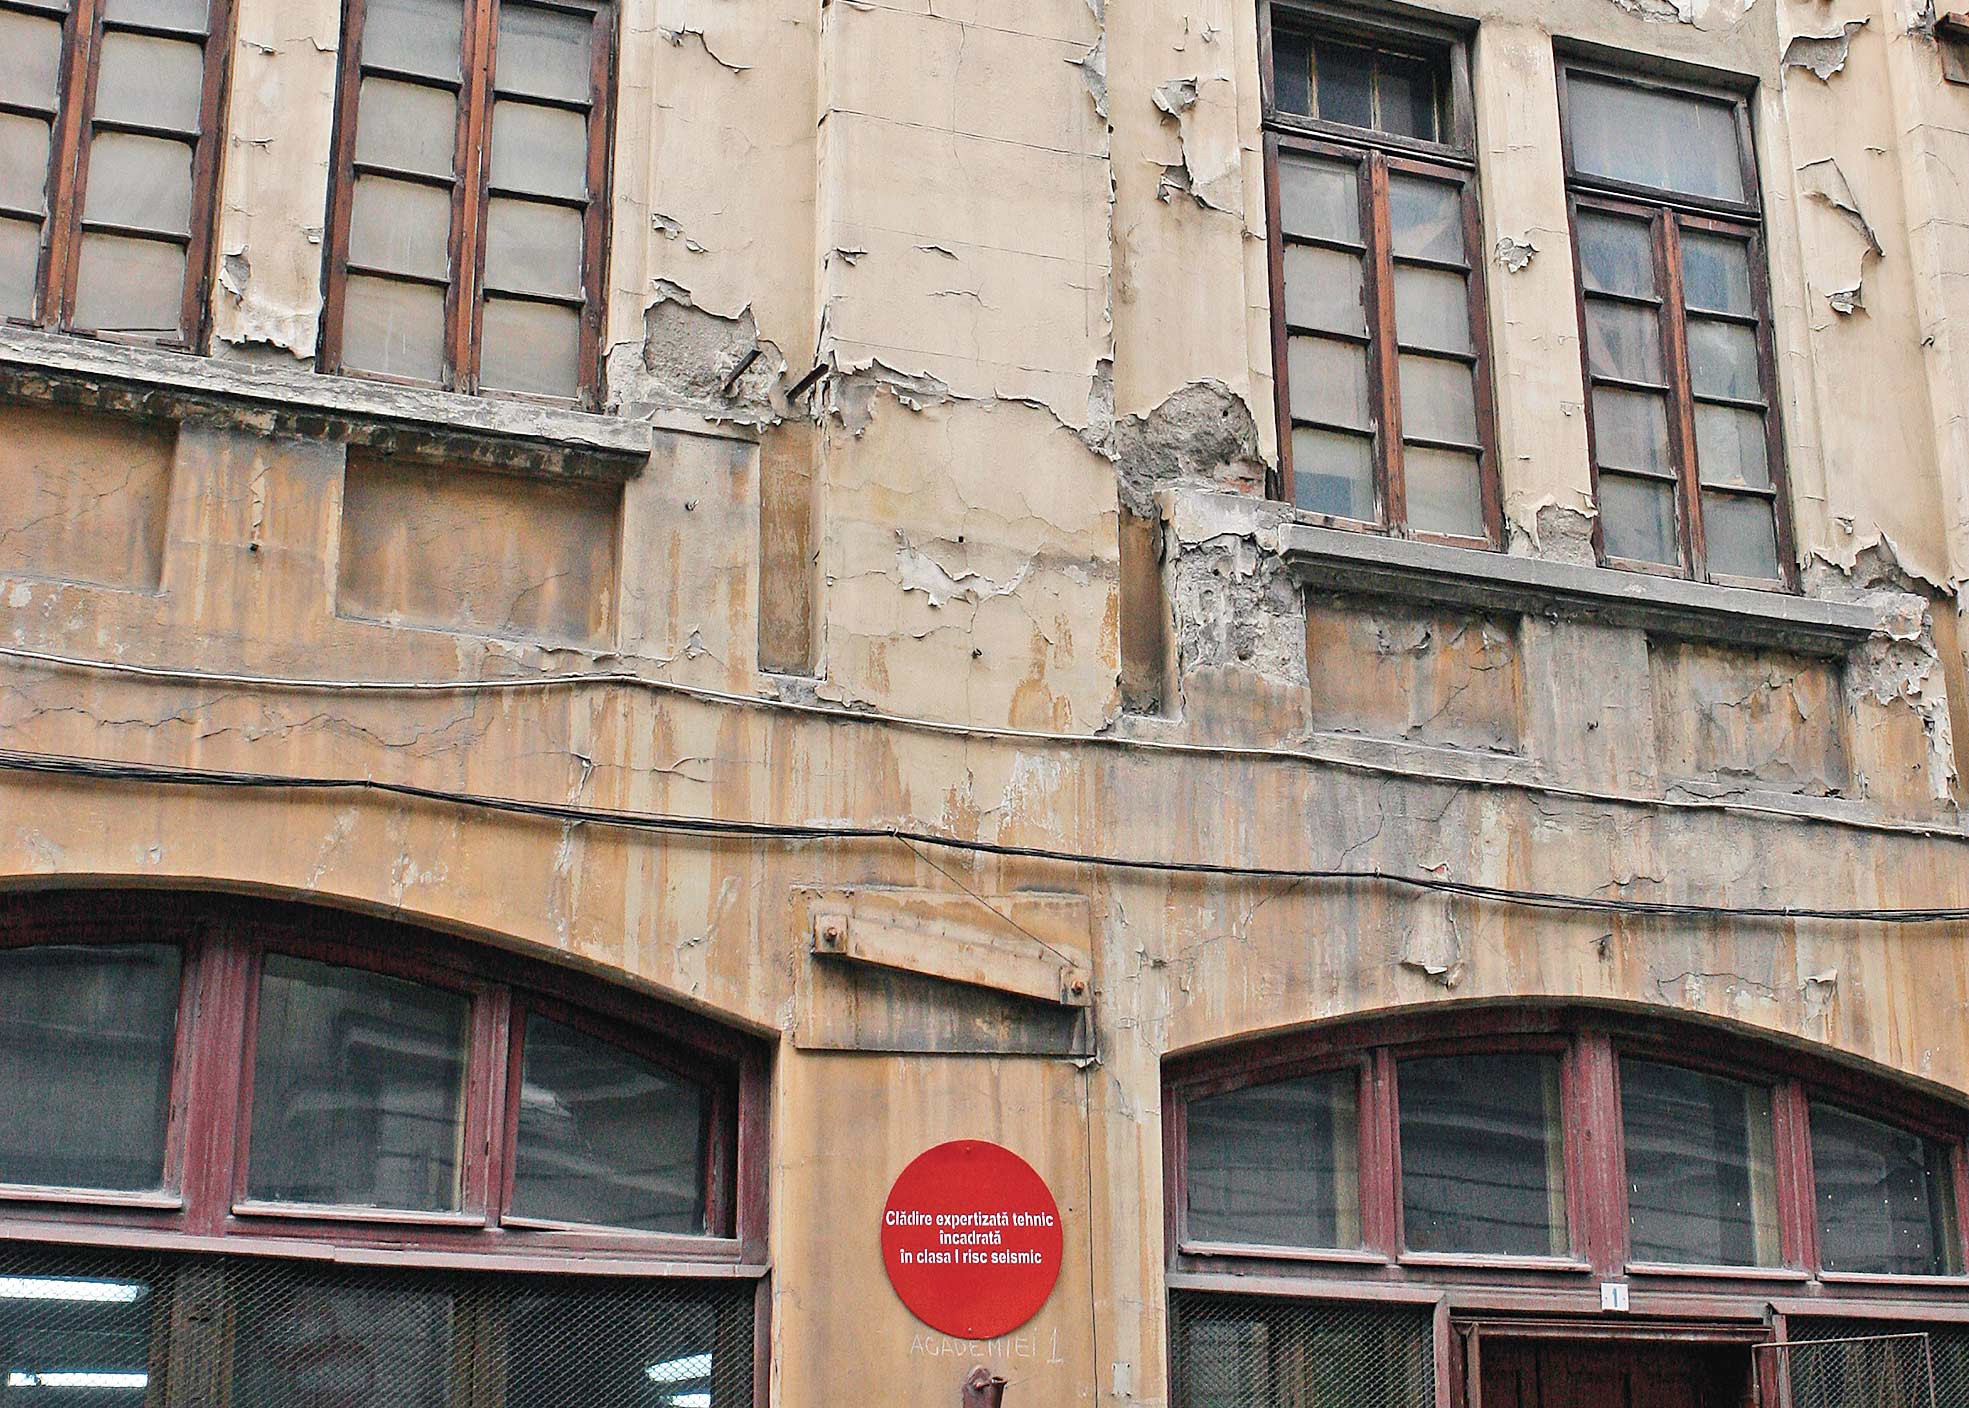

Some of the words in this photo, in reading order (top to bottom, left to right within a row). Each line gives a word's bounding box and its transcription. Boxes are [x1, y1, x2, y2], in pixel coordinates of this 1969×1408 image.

[885, 1210, 933, 1226] Clădire
[935, 1211, 1009, 1230] expertizată
[1012, 1211, 1054, 1227] tehnic
[939, 1229, 1002, 1245] încadrată
[900, 1248, 913, 1264] în
[916, 1248, 952, 1264] clasa
[954, 1248, 959, 1264] I
[962, 1248, 988, 1264] risc
[990, 1248, 1042, 1264] seismic
[1046, 1327, 1064, 1364] 1
